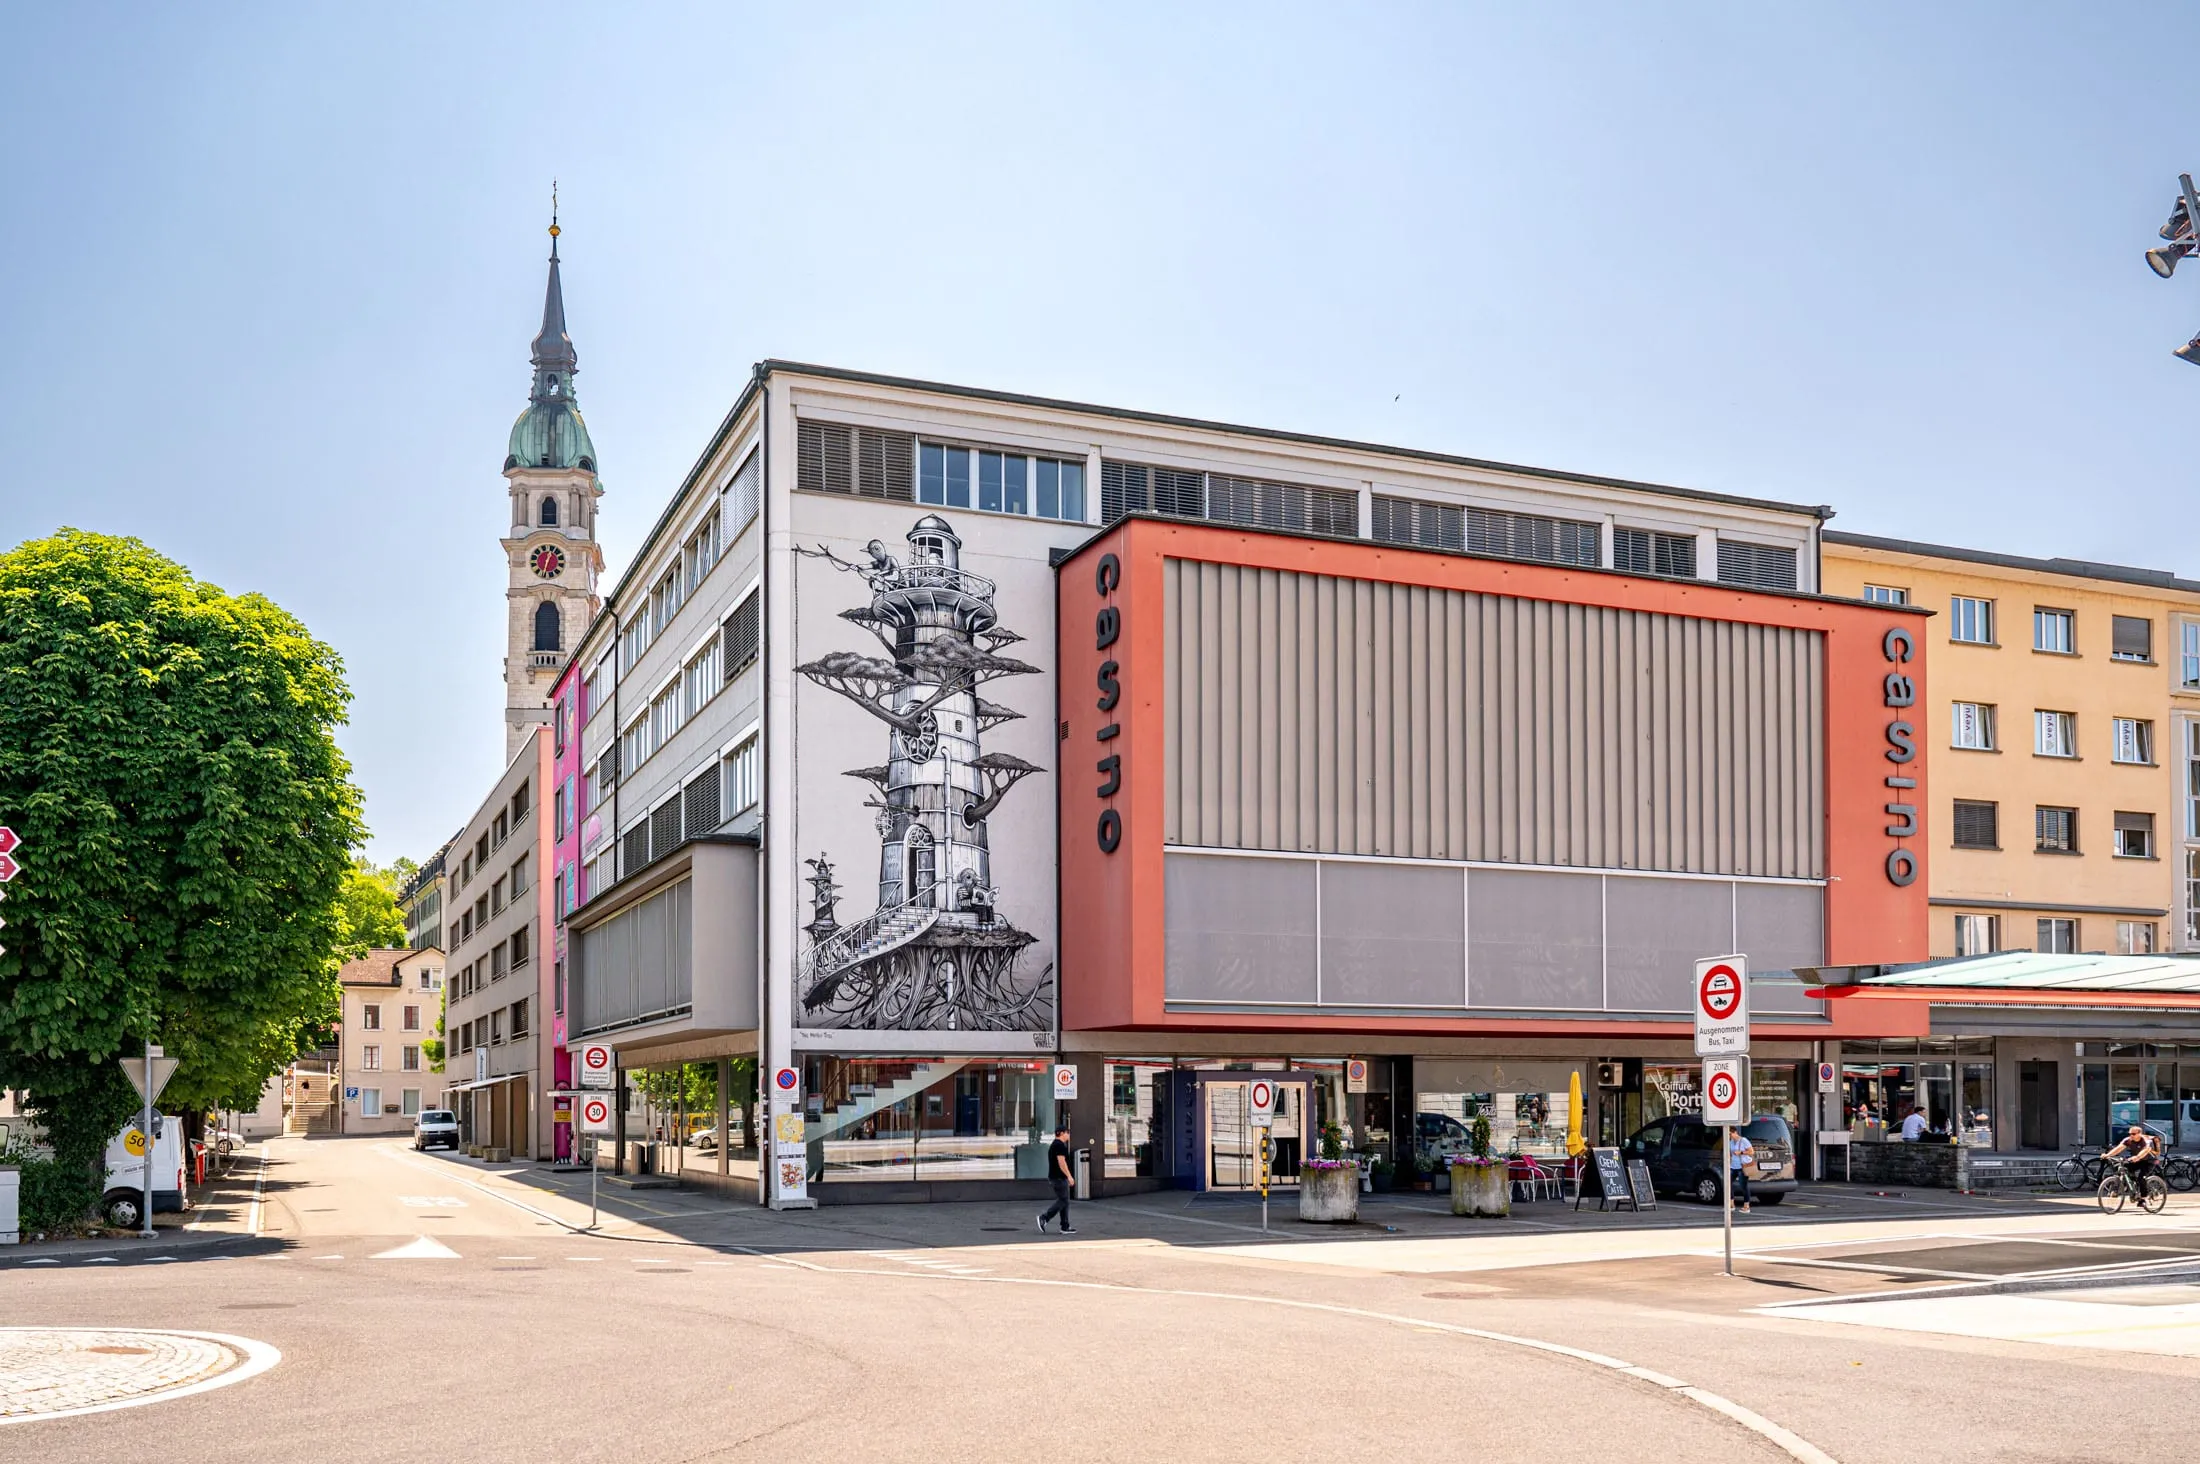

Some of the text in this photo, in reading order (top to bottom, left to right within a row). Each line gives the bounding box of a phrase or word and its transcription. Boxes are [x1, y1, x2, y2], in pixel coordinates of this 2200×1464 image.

[1699, 1025, 1744, 1037] Ausgenommen
[1708, 1037, 1735, 1046] Bus, Taxi
[1713, 1063, 1729, 1071] ZONE
[1659, 1080, 1692, 1091] Coiffure
[1716, 1083, 1728, 1097] 30
[591, 1107, 601, 1116] 30
[1599, 1155, 1620, 1169] CREMA
